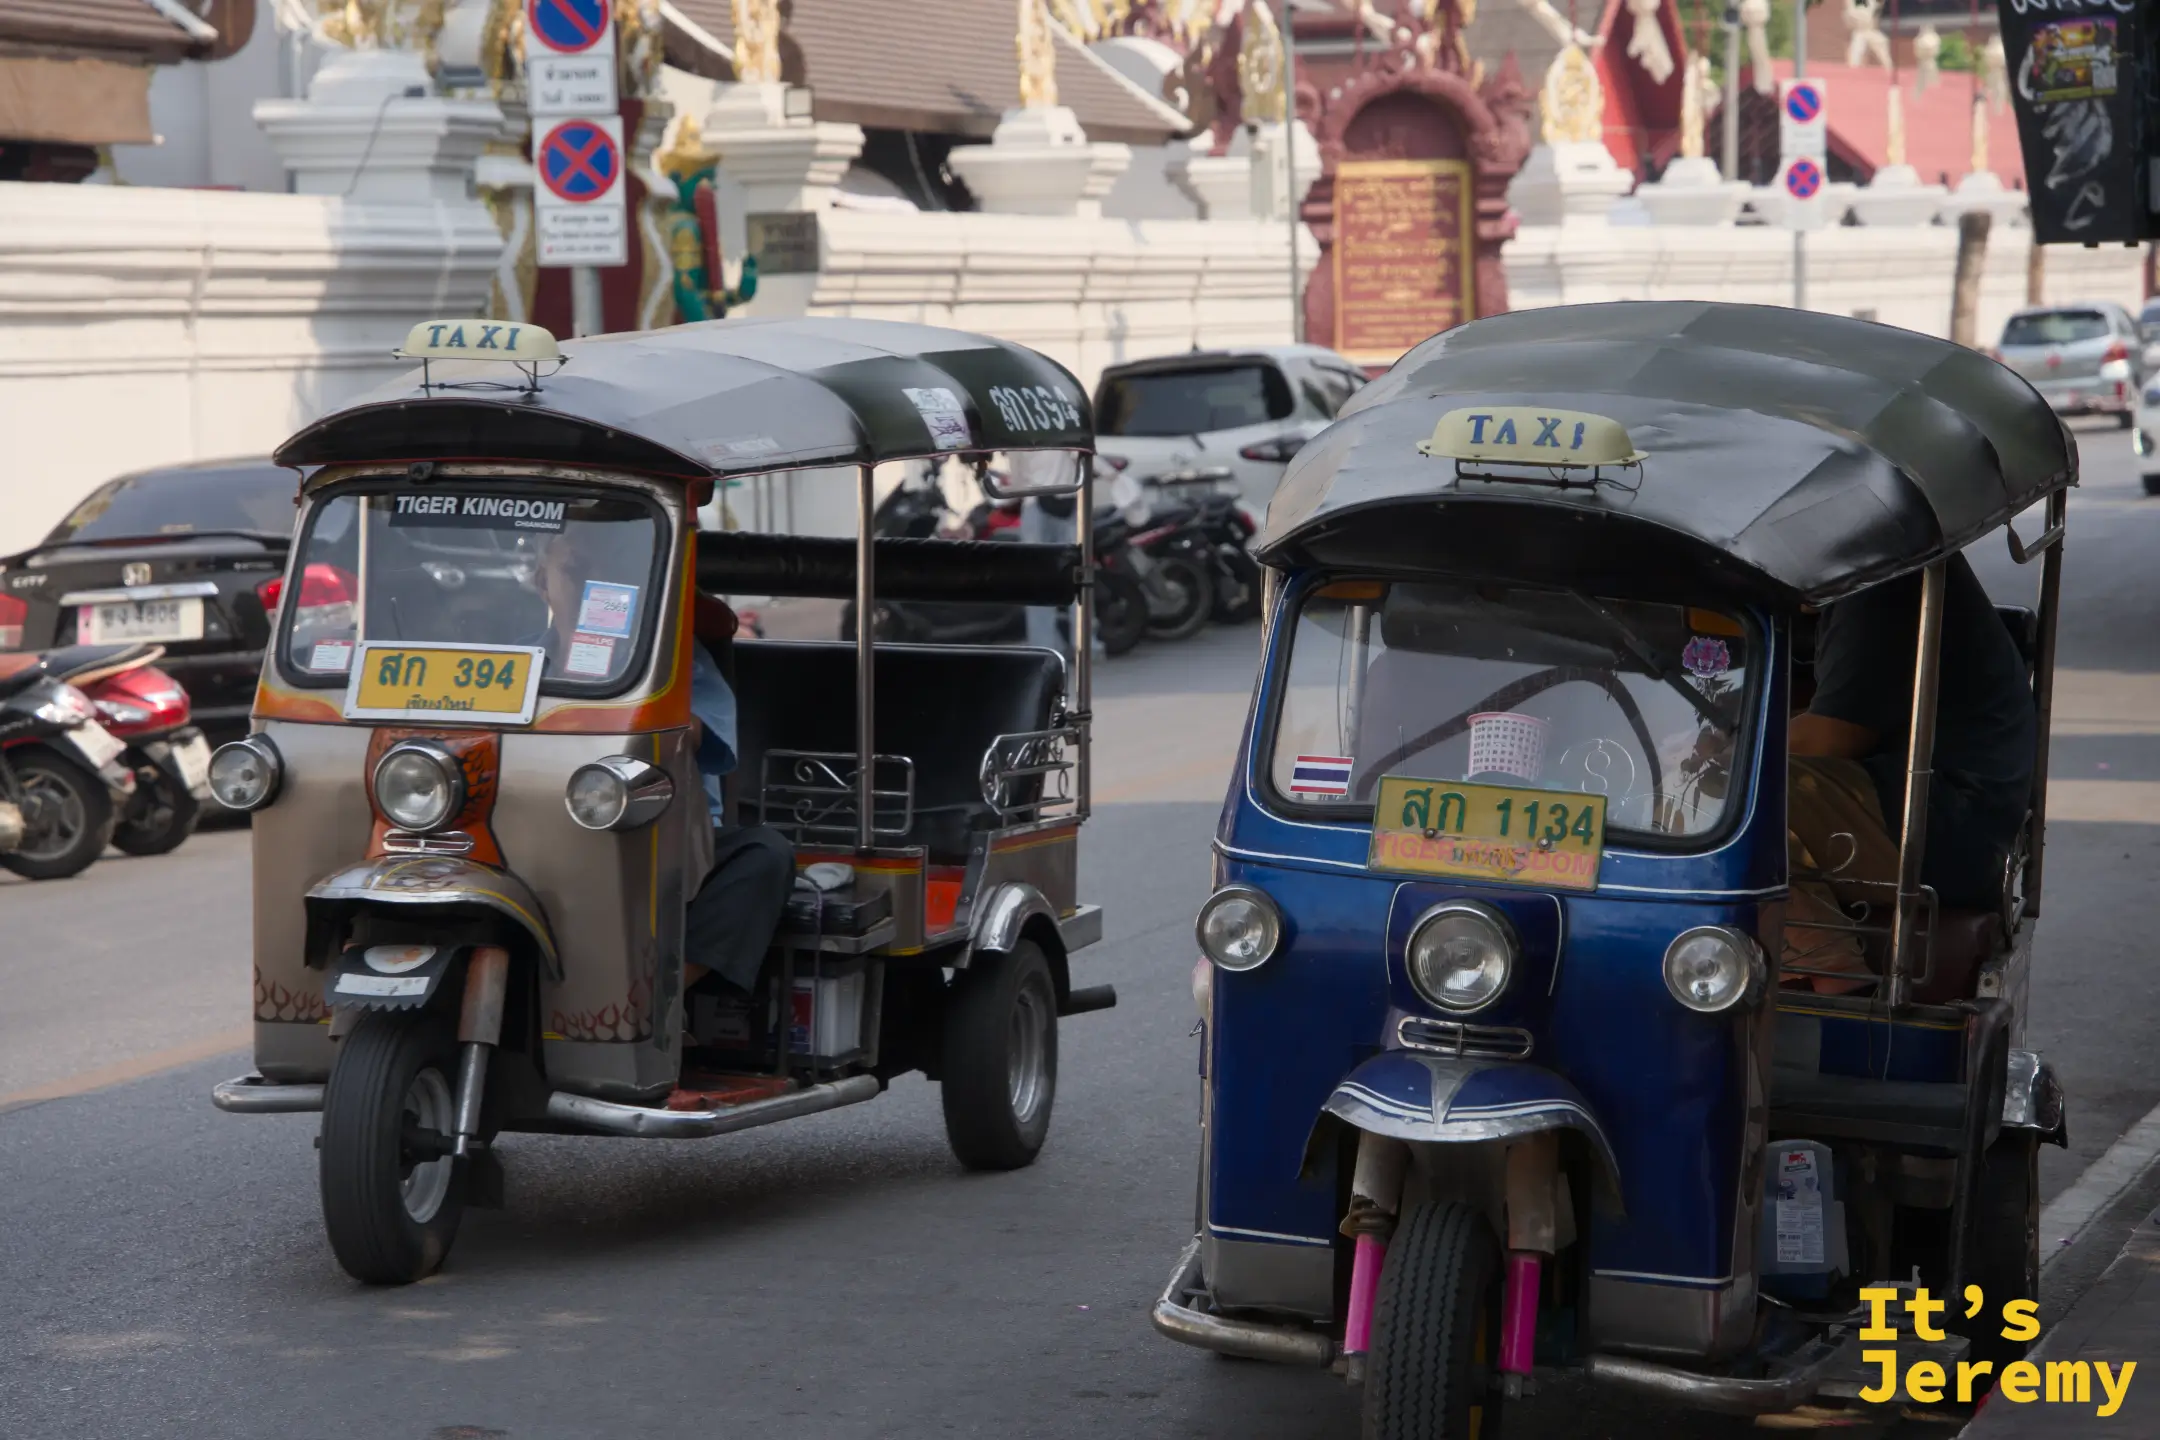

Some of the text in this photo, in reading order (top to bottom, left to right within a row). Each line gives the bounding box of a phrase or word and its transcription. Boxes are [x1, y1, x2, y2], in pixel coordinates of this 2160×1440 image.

[427, 324, 521, 350] TAXI
[1466, 414, 1585, 450] TAXI
[396, 496, 565, 520] TIGER KINGDOM
[378, 652, 427, 687] สก
[453, 657, 515, 690] 394
[1402, 786, 1595, 846] สก 1134
